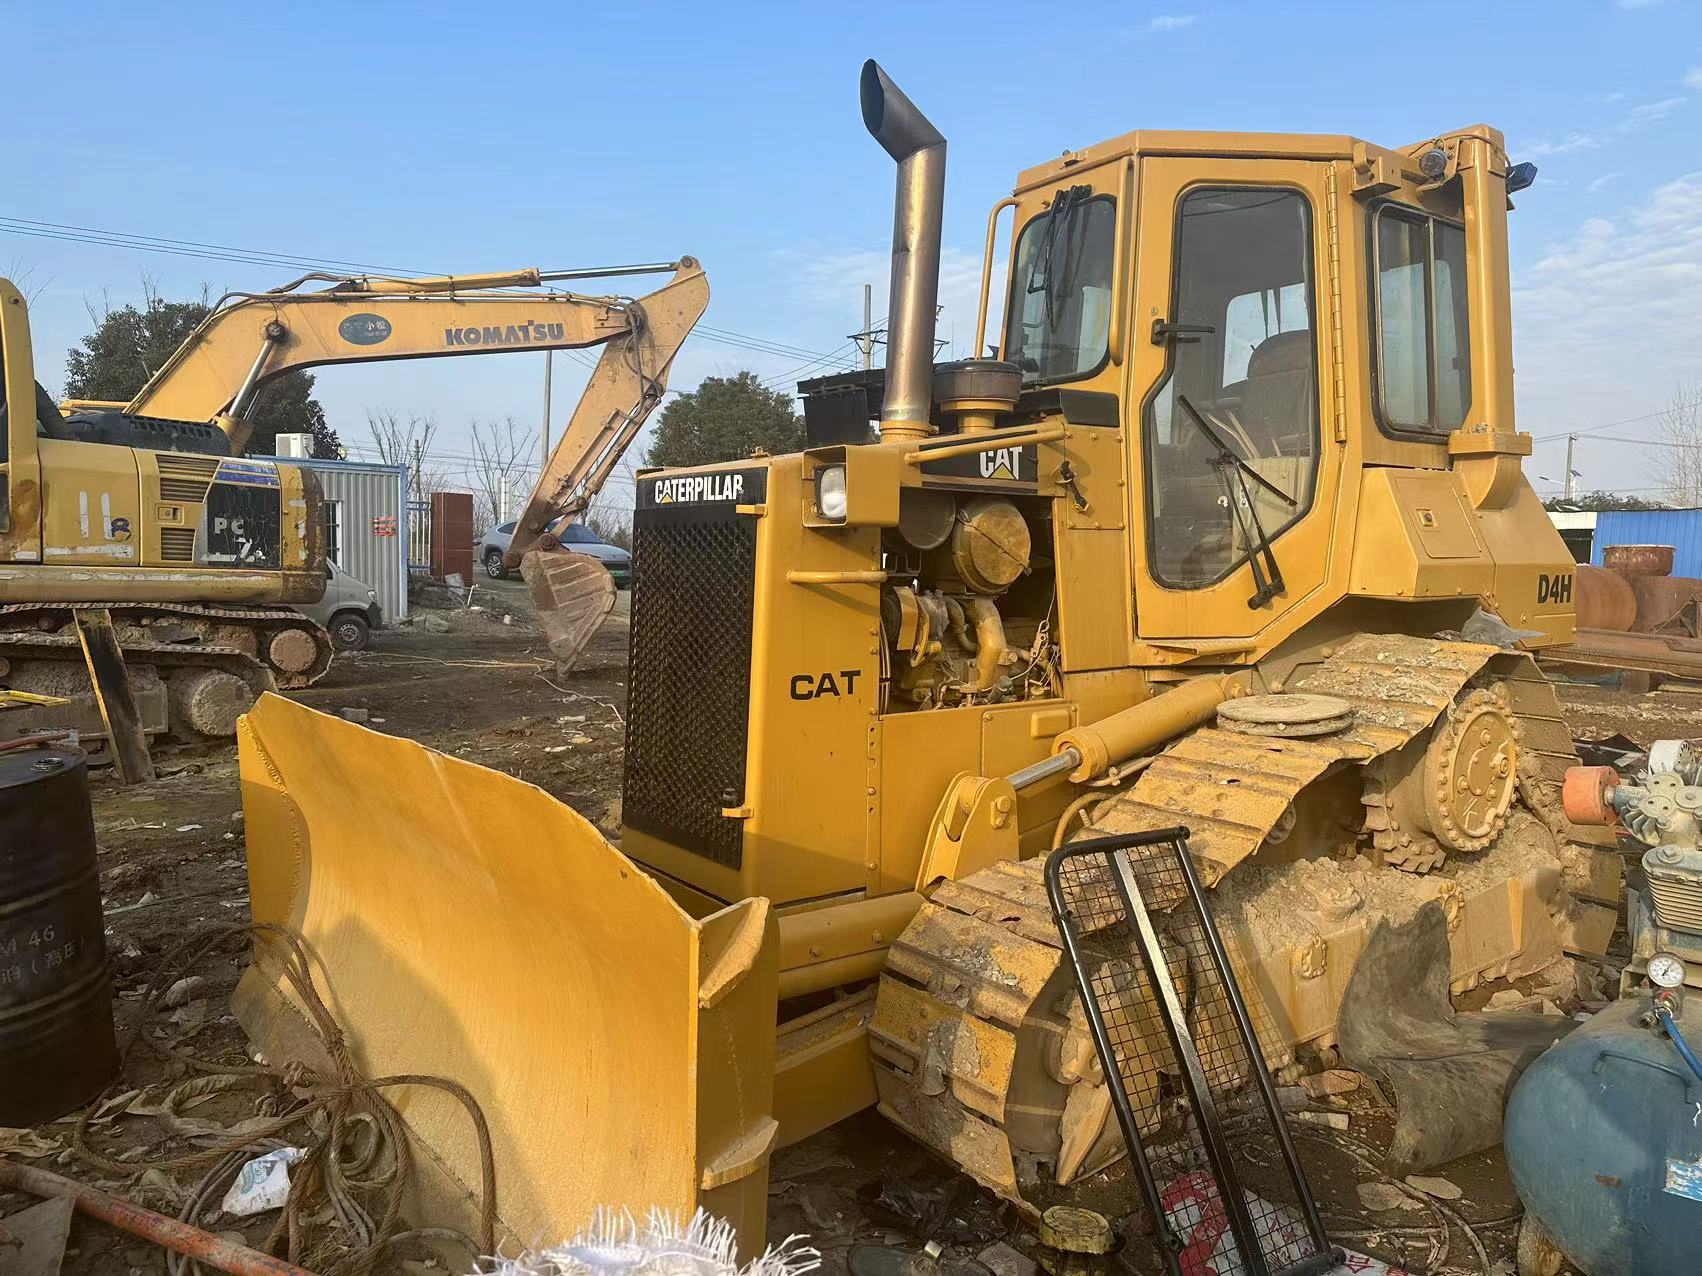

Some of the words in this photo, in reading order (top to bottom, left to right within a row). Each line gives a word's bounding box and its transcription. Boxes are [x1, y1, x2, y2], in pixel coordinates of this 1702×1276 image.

[445, 320, 564, 346] KOMATSU
[980, 446, 1022, 480] CAT
[655, 475, 744, 503] CATERPILLAR
[1537, 574, 1572, 604] D4H
[790, 670, 861, 700] CAT
[28, 925, 55, 946] 46
